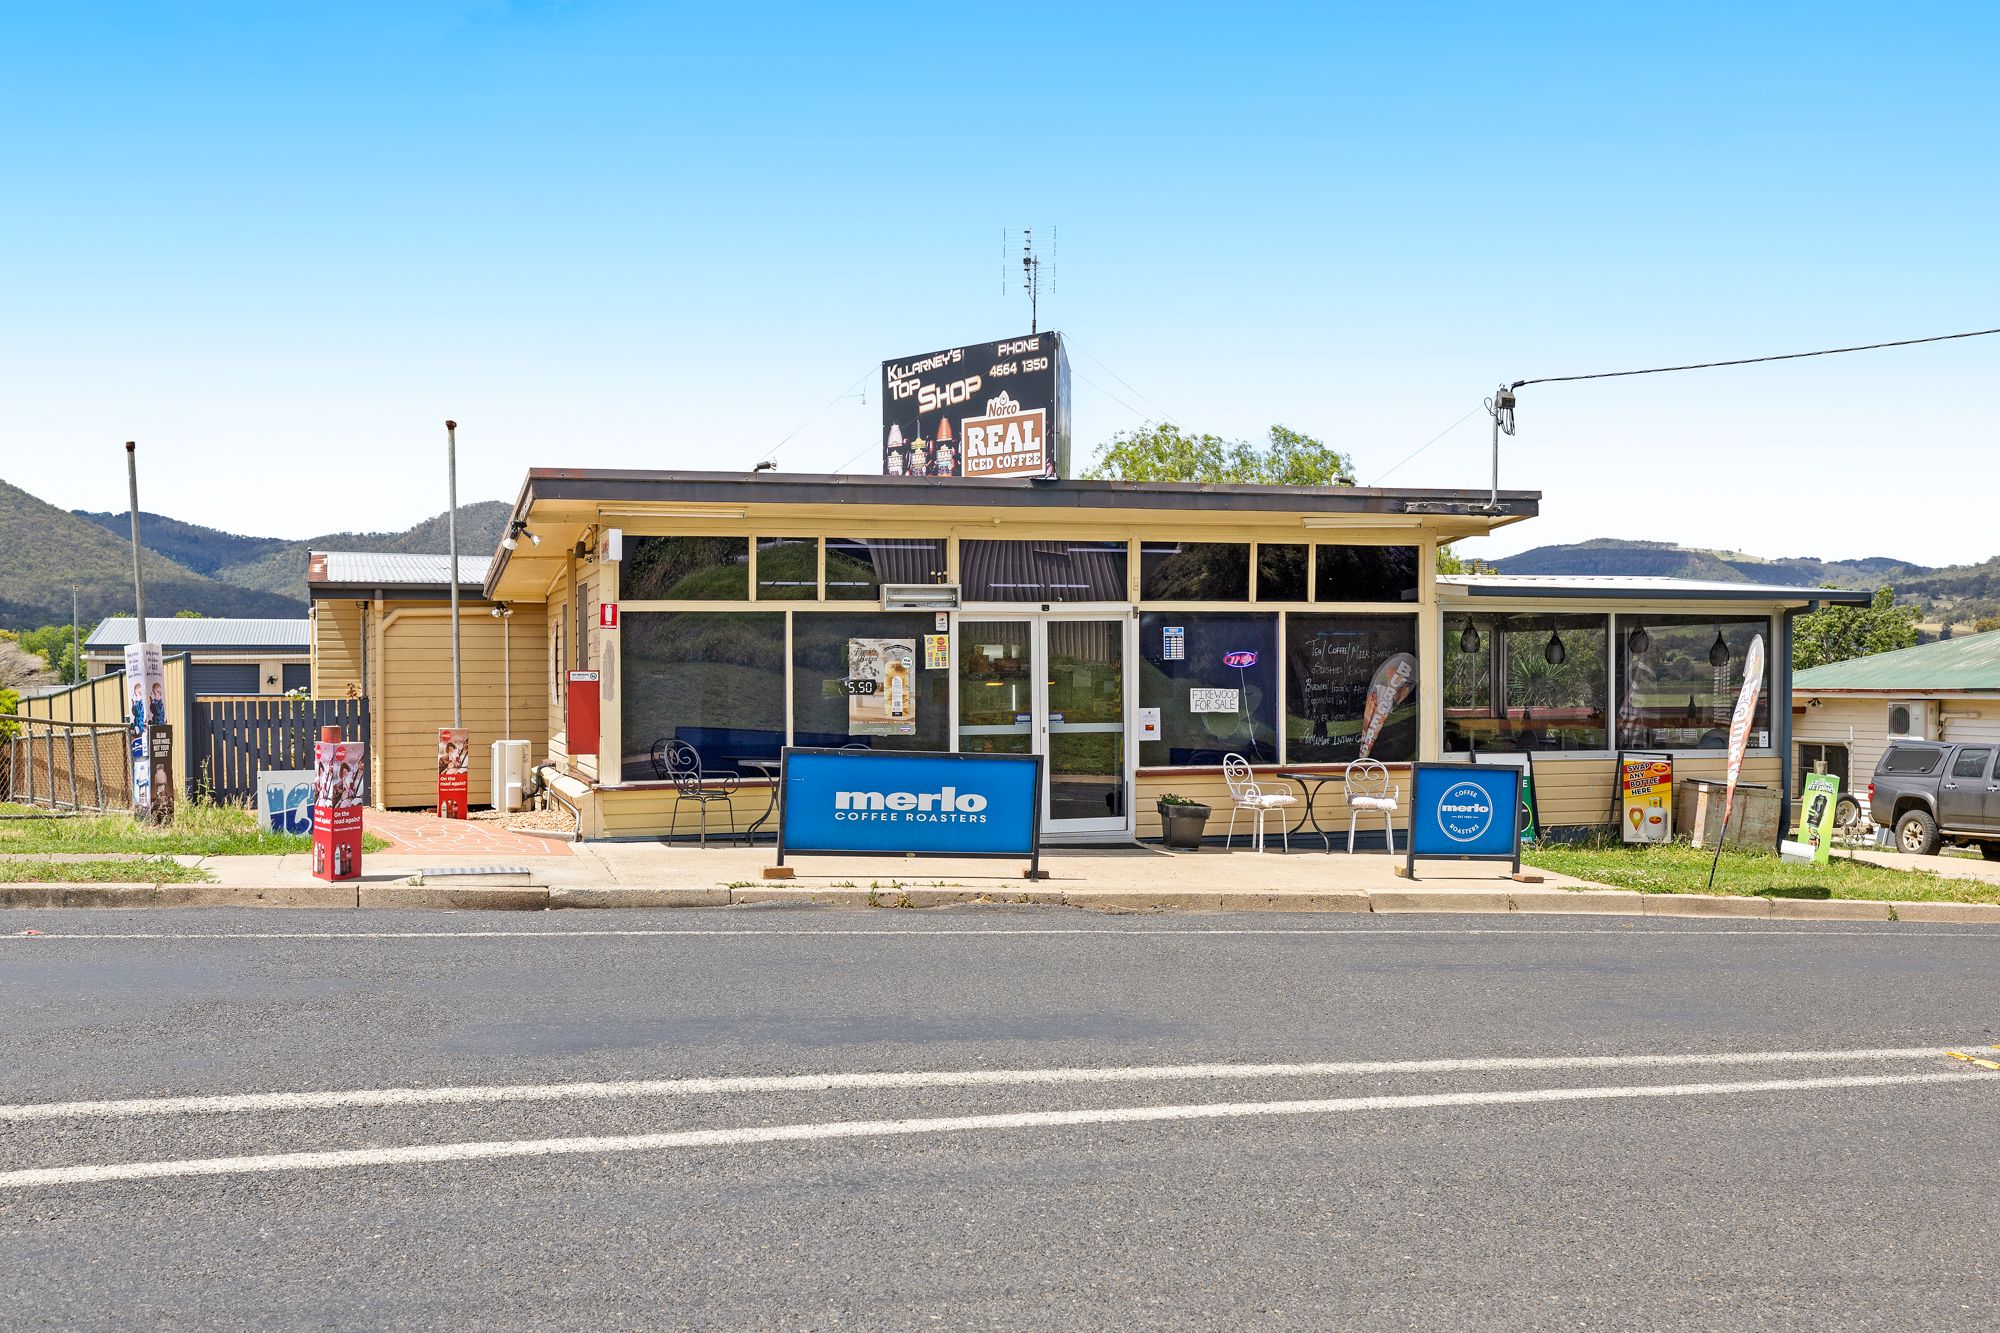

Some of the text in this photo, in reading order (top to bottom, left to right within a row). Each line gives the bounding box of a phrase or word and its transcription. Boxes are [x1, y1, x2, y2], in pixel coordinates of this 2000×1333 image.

[997, 338, 1040, 357] PHONE
[887, 348, 962, 382] KILLARNEY'S
[989, 357, 1049, 377] 4664 1350
[888, 378, 921, 400] TOP
[918, 375, 982, 414] SHOP
[988, 402, 1017, 417] Norco
[967, 420, 1041, 457] REAL
[967, 452, 1041, 472] ICED COFFEE
[1192, 689, 1240, 700] FIREWOOD
[1194, 699, 1236, 711] FOR SALE
[1627, 763, 1650, 772] SWAP
[1629, 771, 1645, 780] ANY
[1630, 777, 1659, 788] BOTTLE
[1454, 789, 1478, 798] COFFEE
[1631, 787, 1652, 795] HERE
[835, 786, 988, 812] merlo
[1441, 803, 1489, 813] merlo
[835, 811, 987, 823] COFFEE ROASTERS
[1449, 823, 1480, 834] ROASTERS
